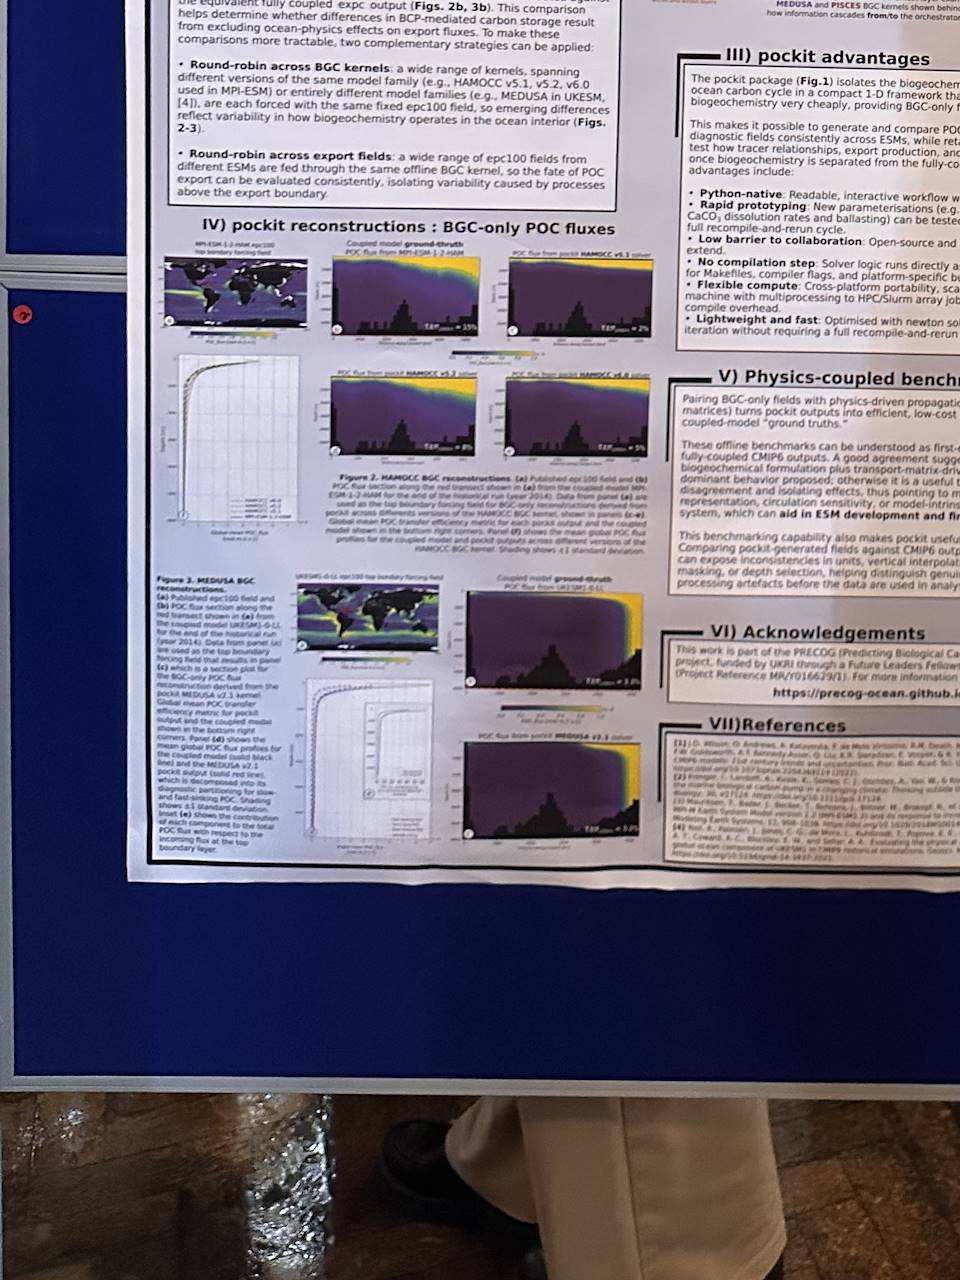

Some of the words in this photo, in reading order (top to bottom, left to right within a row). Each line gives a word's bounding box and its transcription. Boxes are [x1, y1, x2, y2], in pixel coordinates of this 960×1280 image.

[726, 48, 752, 64] III)
[758, 48, 816, 66] pockit
[821, 50, 930, 69] advantages
[691, 74, 710, 84] The
[714, 75, 745, 86] pockit
[749, 76, 792, 88] package
[797, 76, 833, 88] (Fig.1)
[837, 78, 876, 88] isolates
[880, 79, 896, 88] the
[699, 189, 785, 202] Python-native:
[789, 191, 839, 202] Readable,
[844, 192, 899, 202] interactive
[902, 192, 950, 203] workflow
[202, 218, 226, 234] IV)
[232, 218, 286, 236] pockit
[291, 219, 426, 234] reconstructions
[431, 223, 437, 234] :
[443, 221, 520, 238] BGC-only
[525, 222, 560, 235] POC
[565, 222, 616, 236] fluxes
[696, 314, 767, 328] Lightweight
[771, 316, 793, 326] and
[796, 316, 820, 326] fast:
[825, 316, 877, 328] Optimised
[881, 317, 902, 327] with
[906, 319, 944, 328] newton
[718, 369, 738, 386] V)
[745, 369, 895, 390] Physics-coupled
[710, 623, 737, 640] VI)
[743, 624, 926, 643] Acknowledgements
